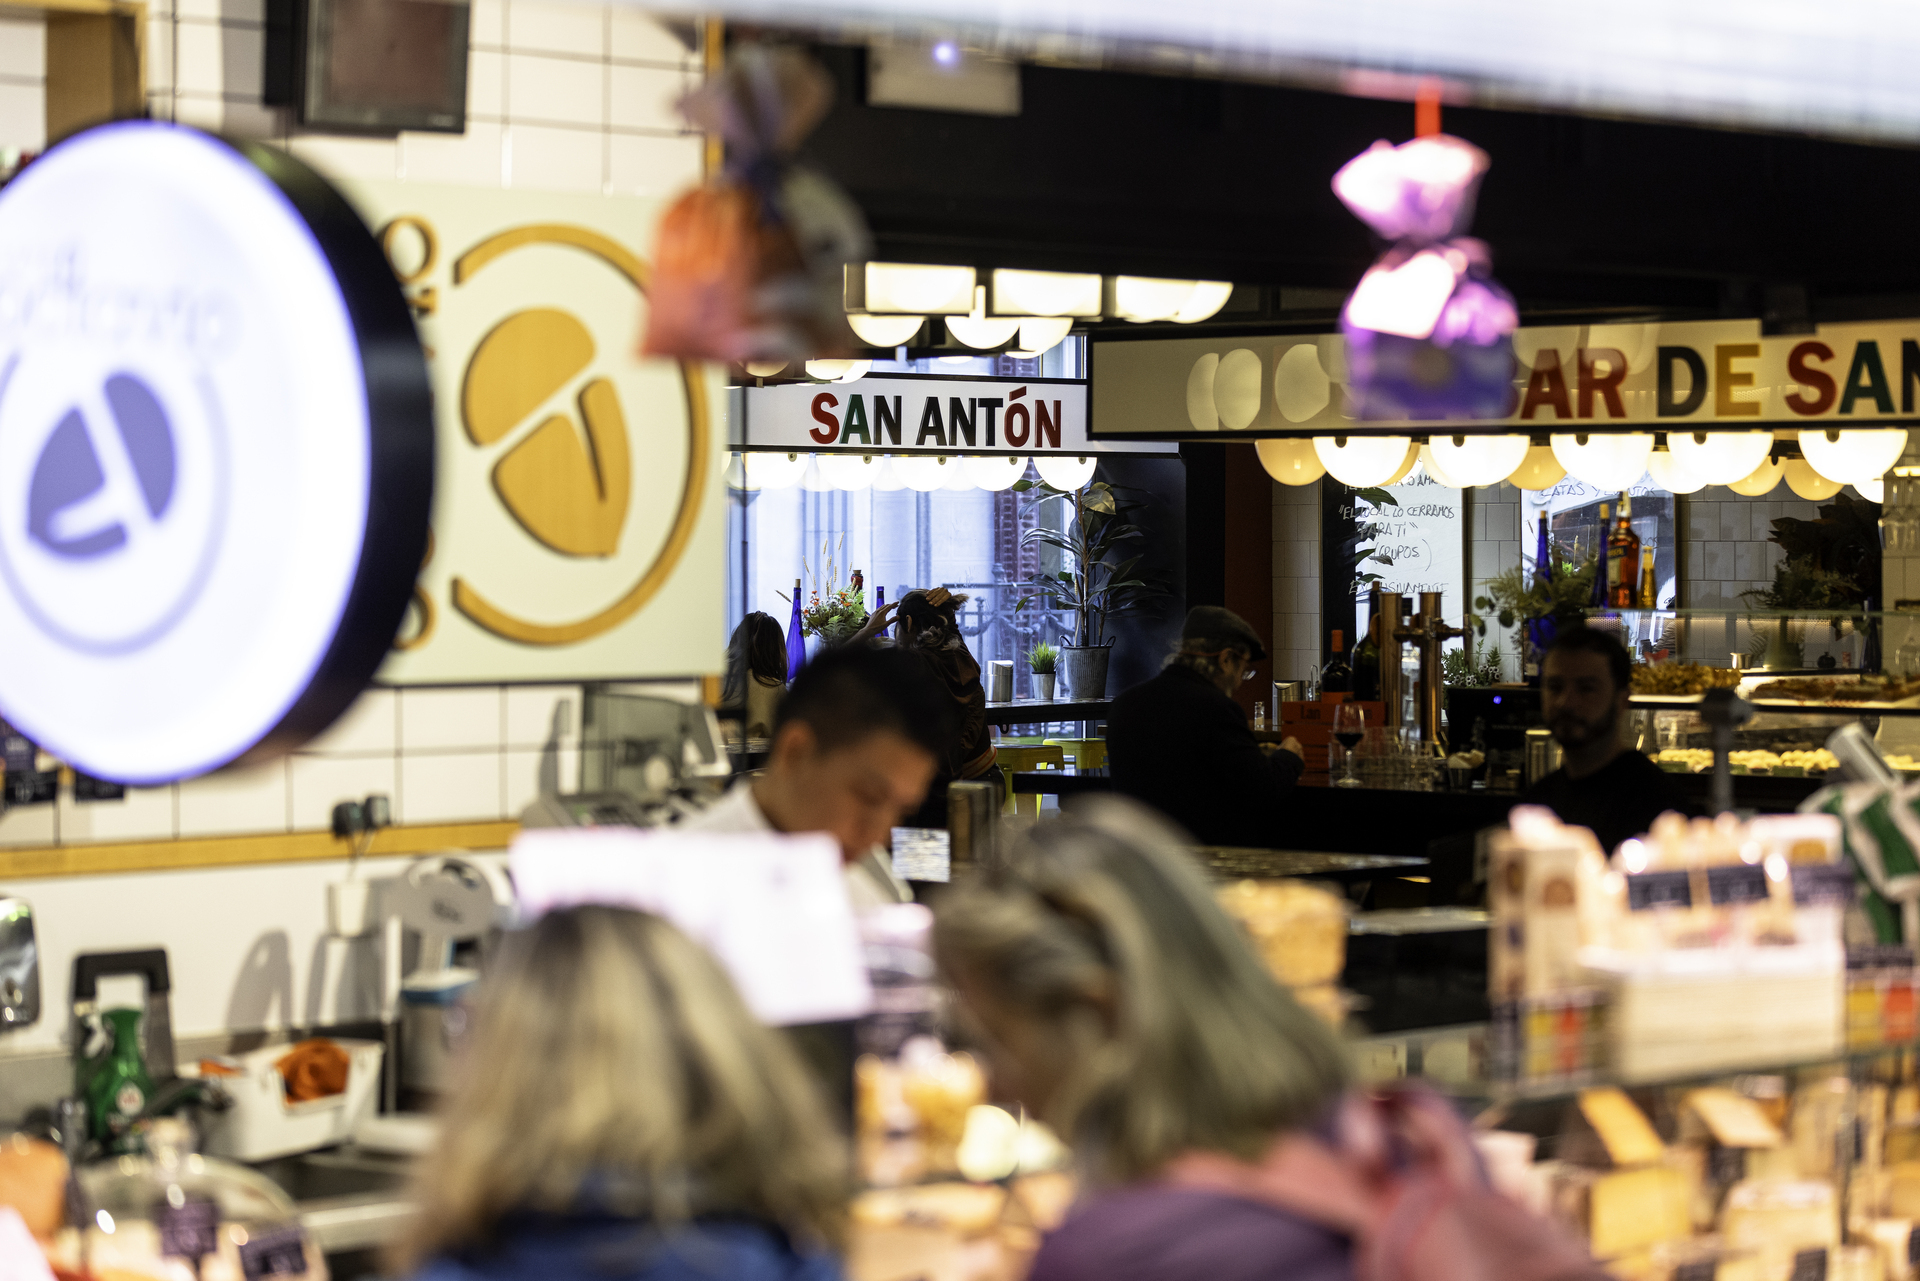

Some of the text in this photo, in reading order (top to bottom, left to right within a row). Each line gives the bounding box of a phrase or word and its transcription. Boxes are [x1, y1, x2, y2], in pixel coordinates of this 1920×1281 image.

[1507, 347, 1627, 419] AR
[1657, 343, 1761, 419] DE
[808, 386, 1062, 448] SAN ANTÓN
